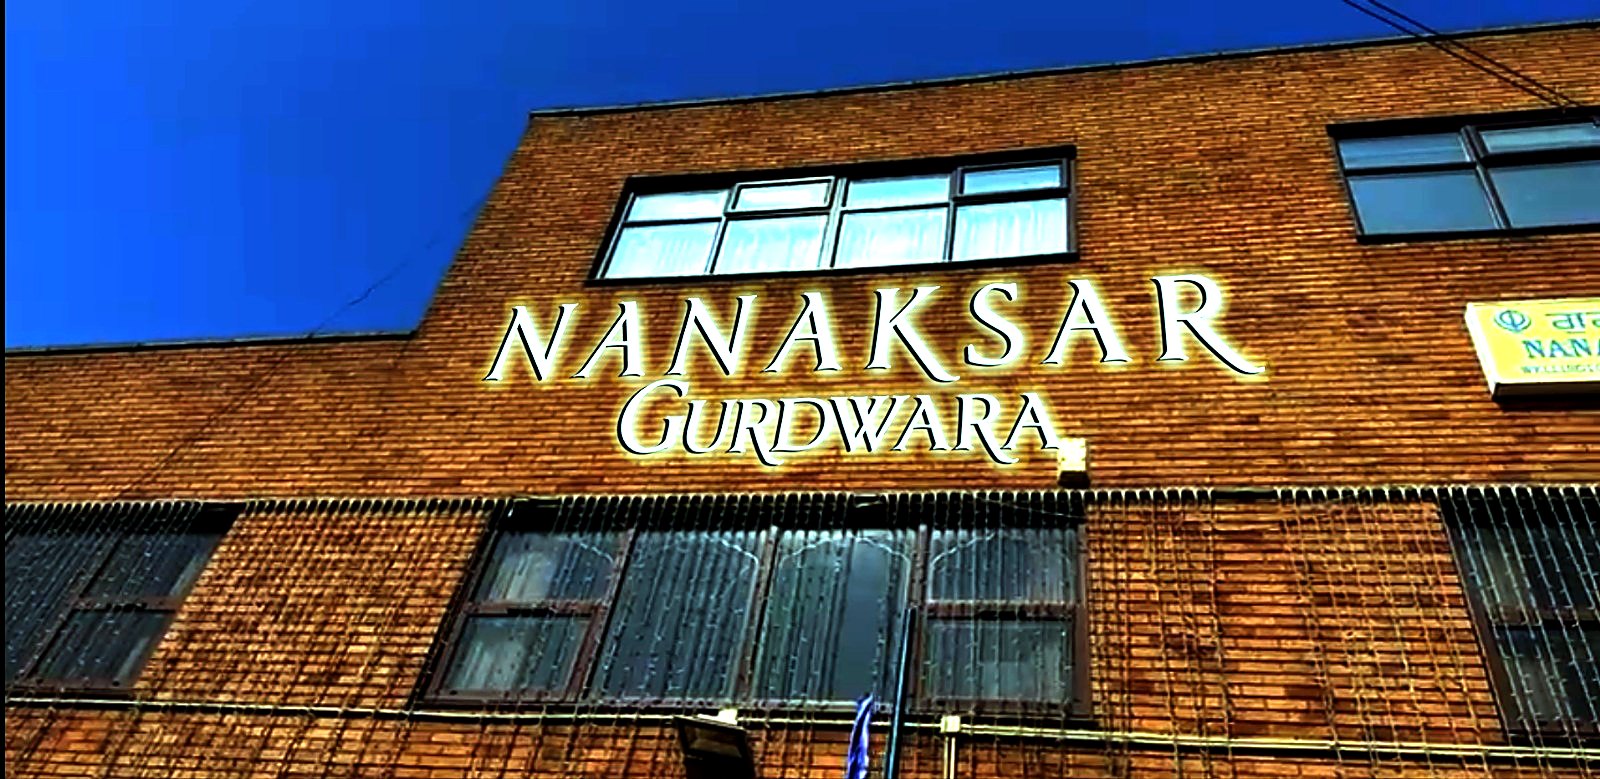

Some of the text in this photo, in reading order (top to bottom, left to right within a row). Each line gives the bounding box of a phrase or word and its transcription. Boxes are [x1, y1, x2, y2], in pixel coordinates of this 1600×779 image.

[482, 274, 1266, 383] NANAKSAR
[1521, 338, 1600, 359] NAN
[616, 379, 1060, 466] GURDWARA
